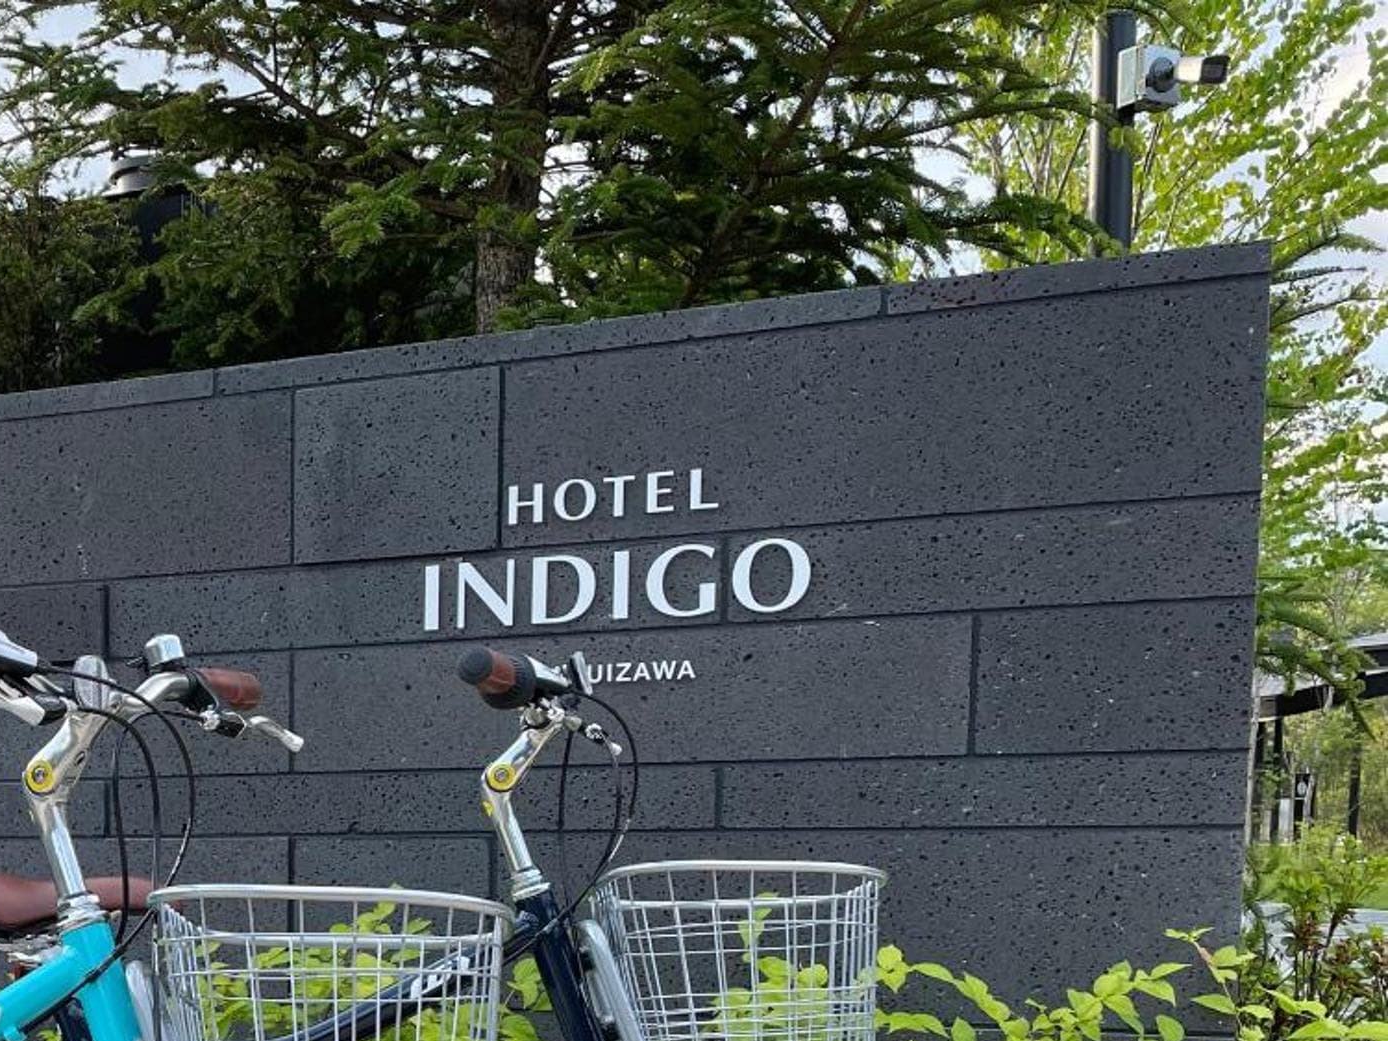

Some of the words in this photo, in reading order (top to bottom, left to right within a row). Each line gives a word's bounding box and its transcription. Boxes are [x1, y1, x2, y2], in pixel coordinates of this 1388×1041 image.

[508, 468, 719, 525] HOTEL
[423, 538, 811, 631] INDIGO
[553, 659, 696, 684] UIZAWA
